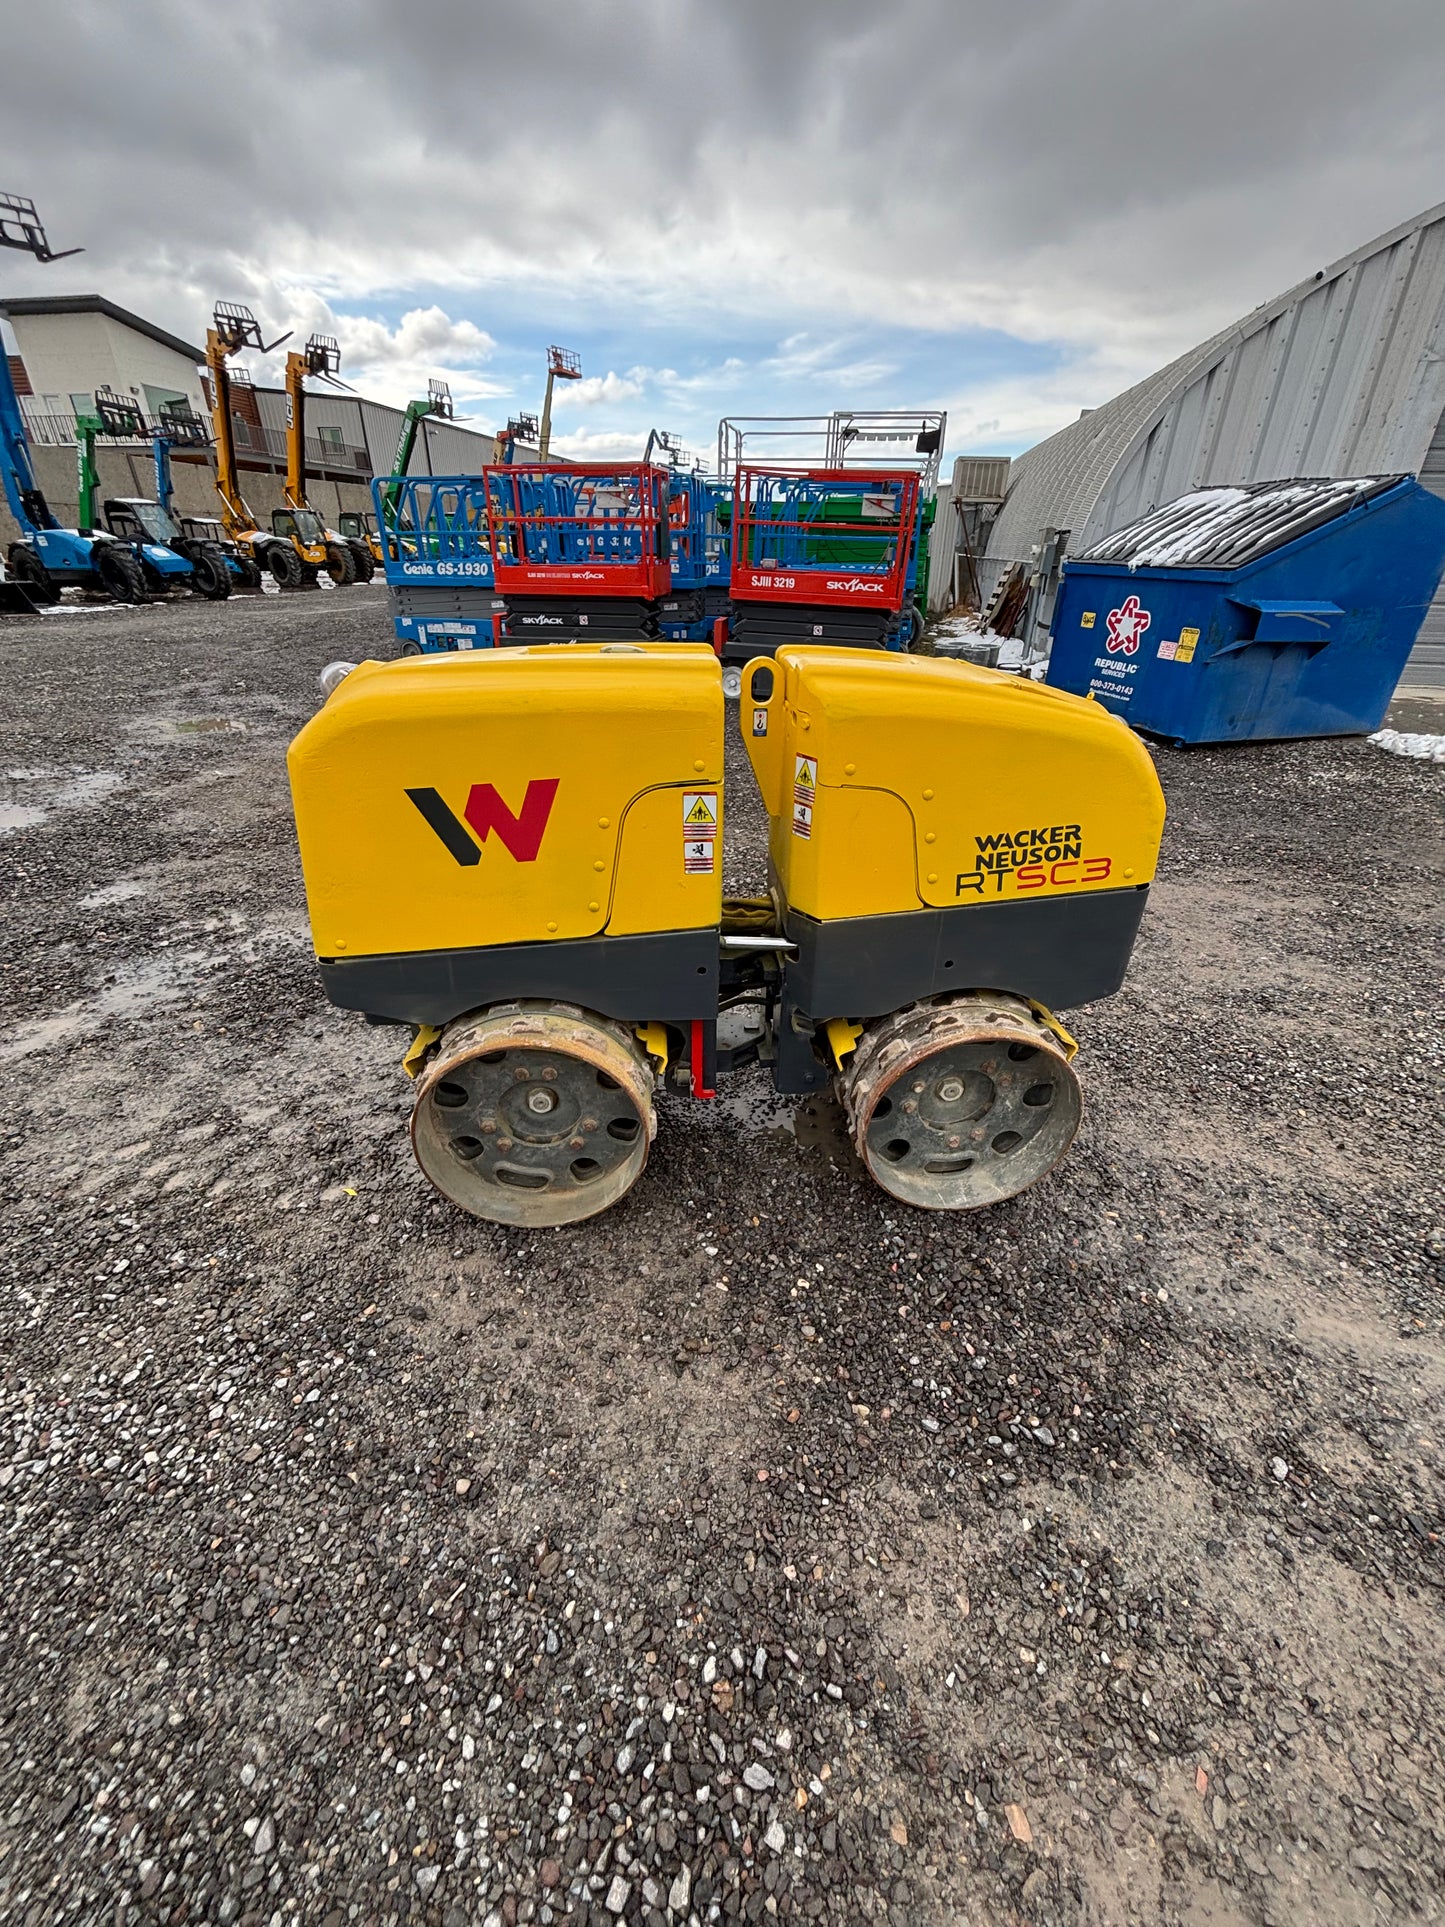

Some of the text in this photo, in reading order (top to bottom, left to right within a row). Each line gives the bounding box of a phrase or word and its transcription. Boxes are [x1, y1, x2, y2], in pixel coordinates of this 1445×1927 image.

[286, 393, 294, 430] JCB
[393, 429, 407, 474] SKYTRAK
[403, 562, 489, 576] Genie GS-1930
[572, 570, 605, 580] SKYJACK
[751, 575, 796, 589] SJIII 3219
[826, 578, 884, 593] SKYJACK
[522, 614, 564, 625] SKYJACK
[1094, 657, 1138, 674] REPUBLIC
[1101, 668, 1126, 679] SERVICES
[974, 824, 1083, 852] WACKER
[975, 842, 1082, 872] NEUSON
